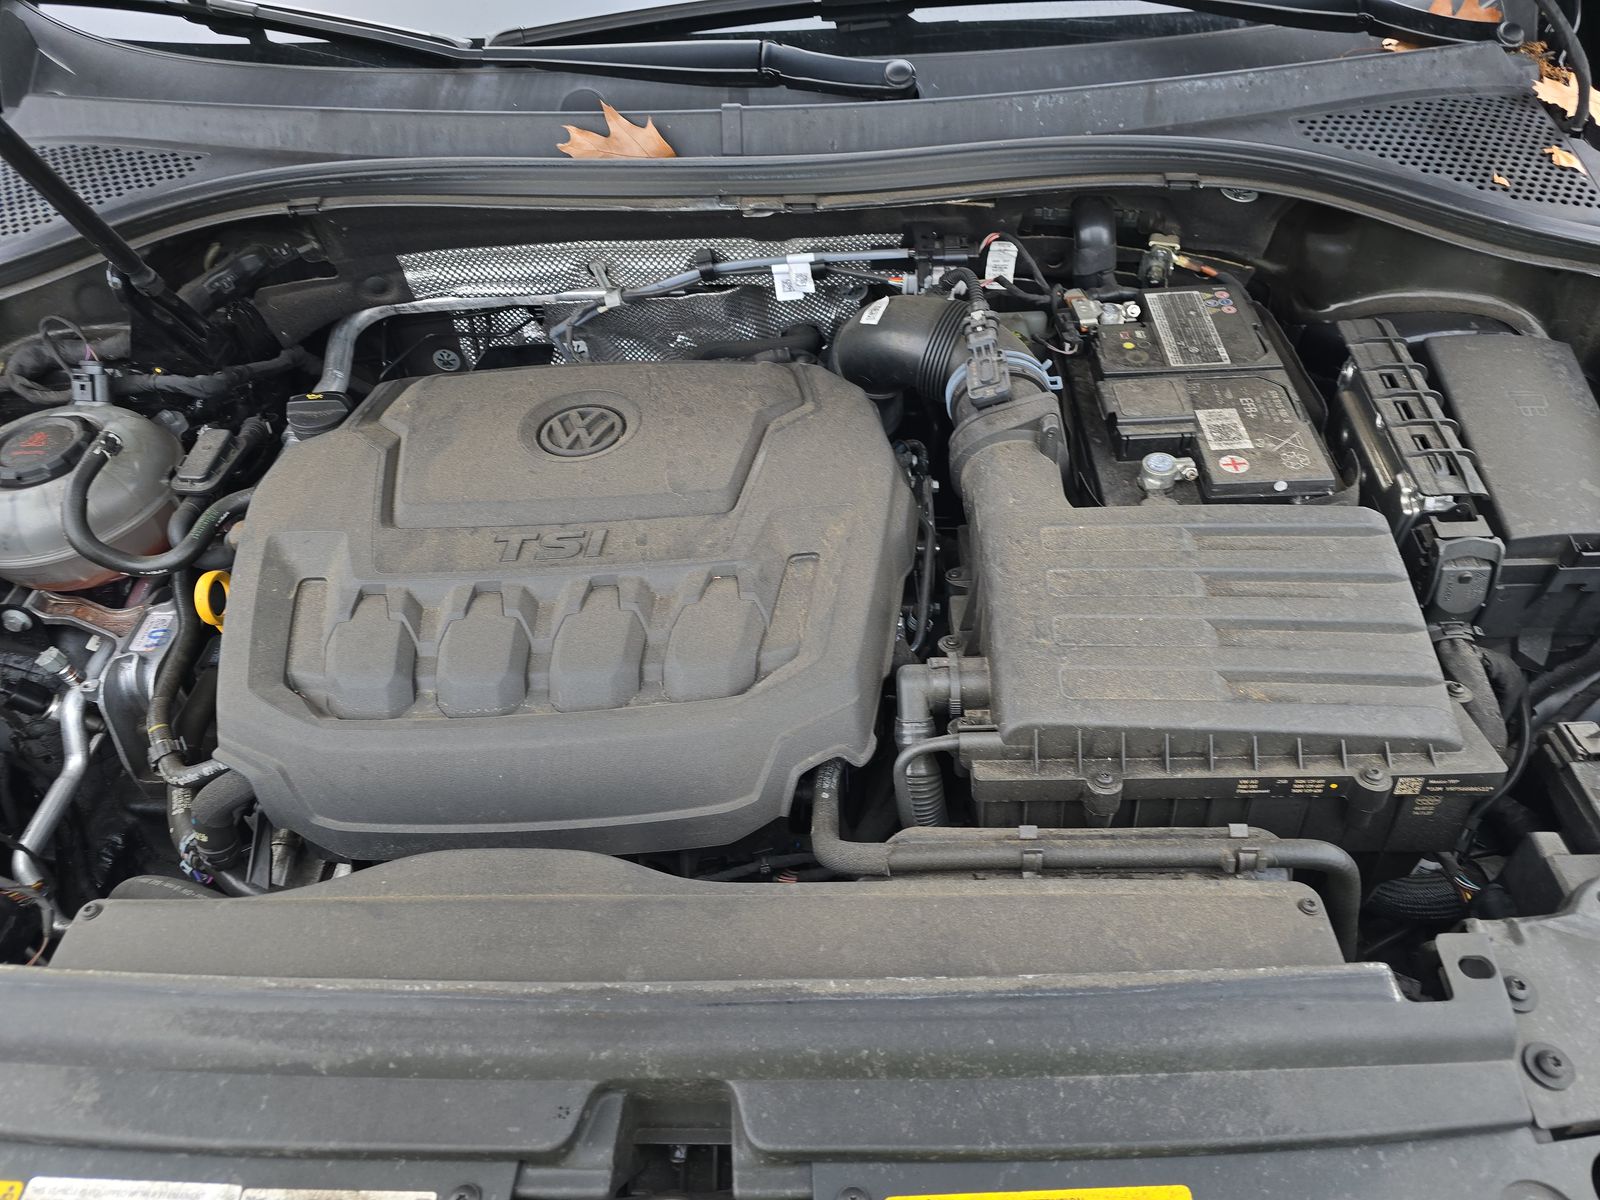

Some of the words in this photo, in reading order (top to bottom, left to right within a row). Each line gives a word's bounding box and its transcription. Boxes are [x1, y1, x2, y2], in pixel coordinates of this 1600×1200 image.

[1239, 397, 1258, 419] EFB+
[540, 406, 622, 454] VW
[494, 528, 609, 563] TSI
